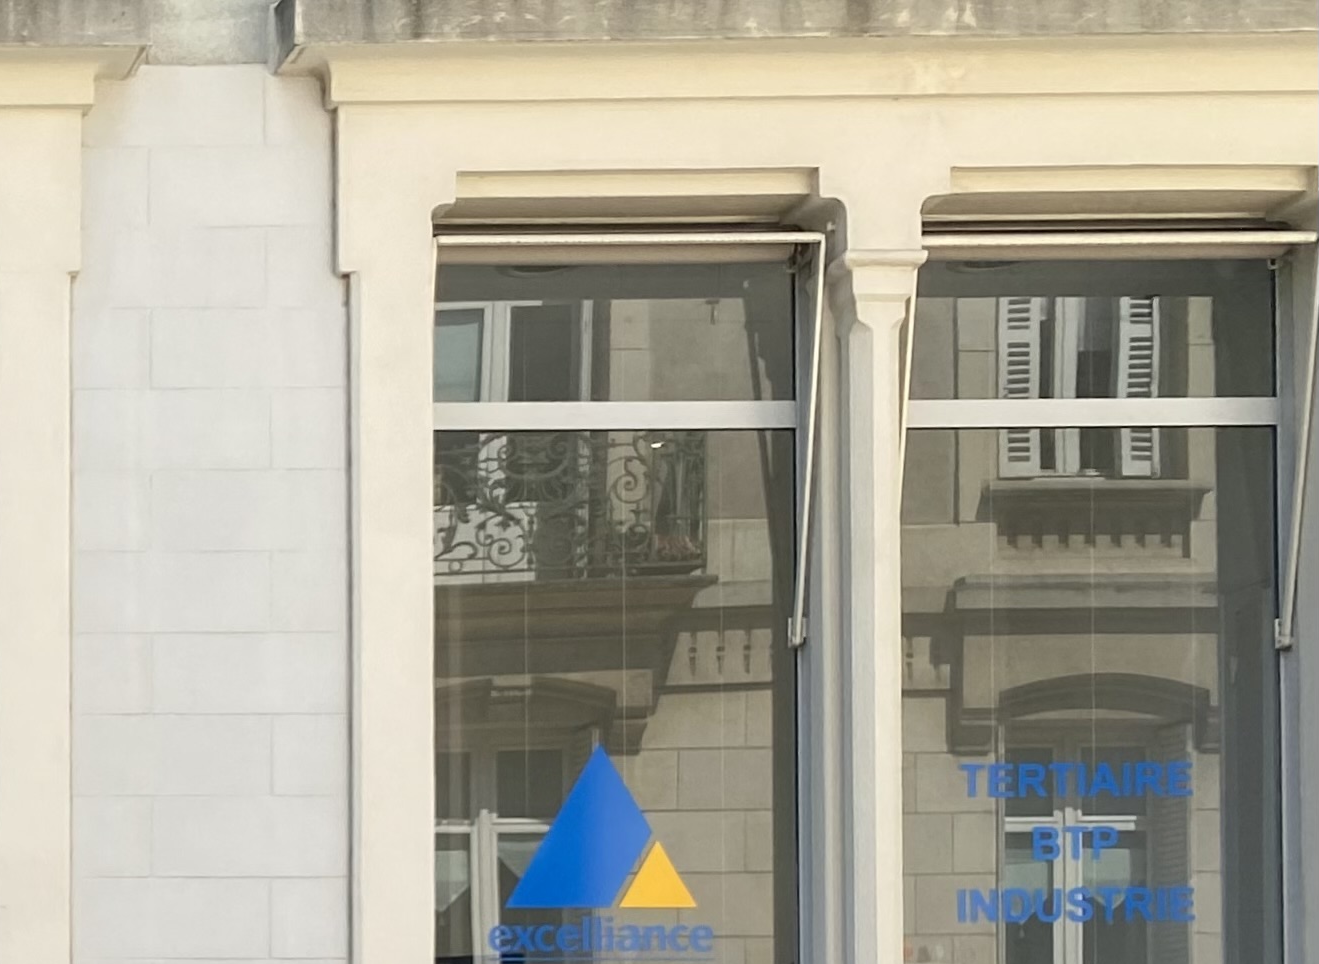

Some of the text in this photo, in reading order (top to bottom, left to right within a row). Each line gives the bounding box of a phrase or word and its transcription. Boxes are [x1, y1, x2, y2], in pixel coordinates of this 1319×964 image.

[959, 762, 1194, 798] TERTIAIRE
[1032, 826, 1119, 861] BTP
[957, 887, 1196, 923] INDUSTRIE
[488, 916, 714, 952] excelliance
